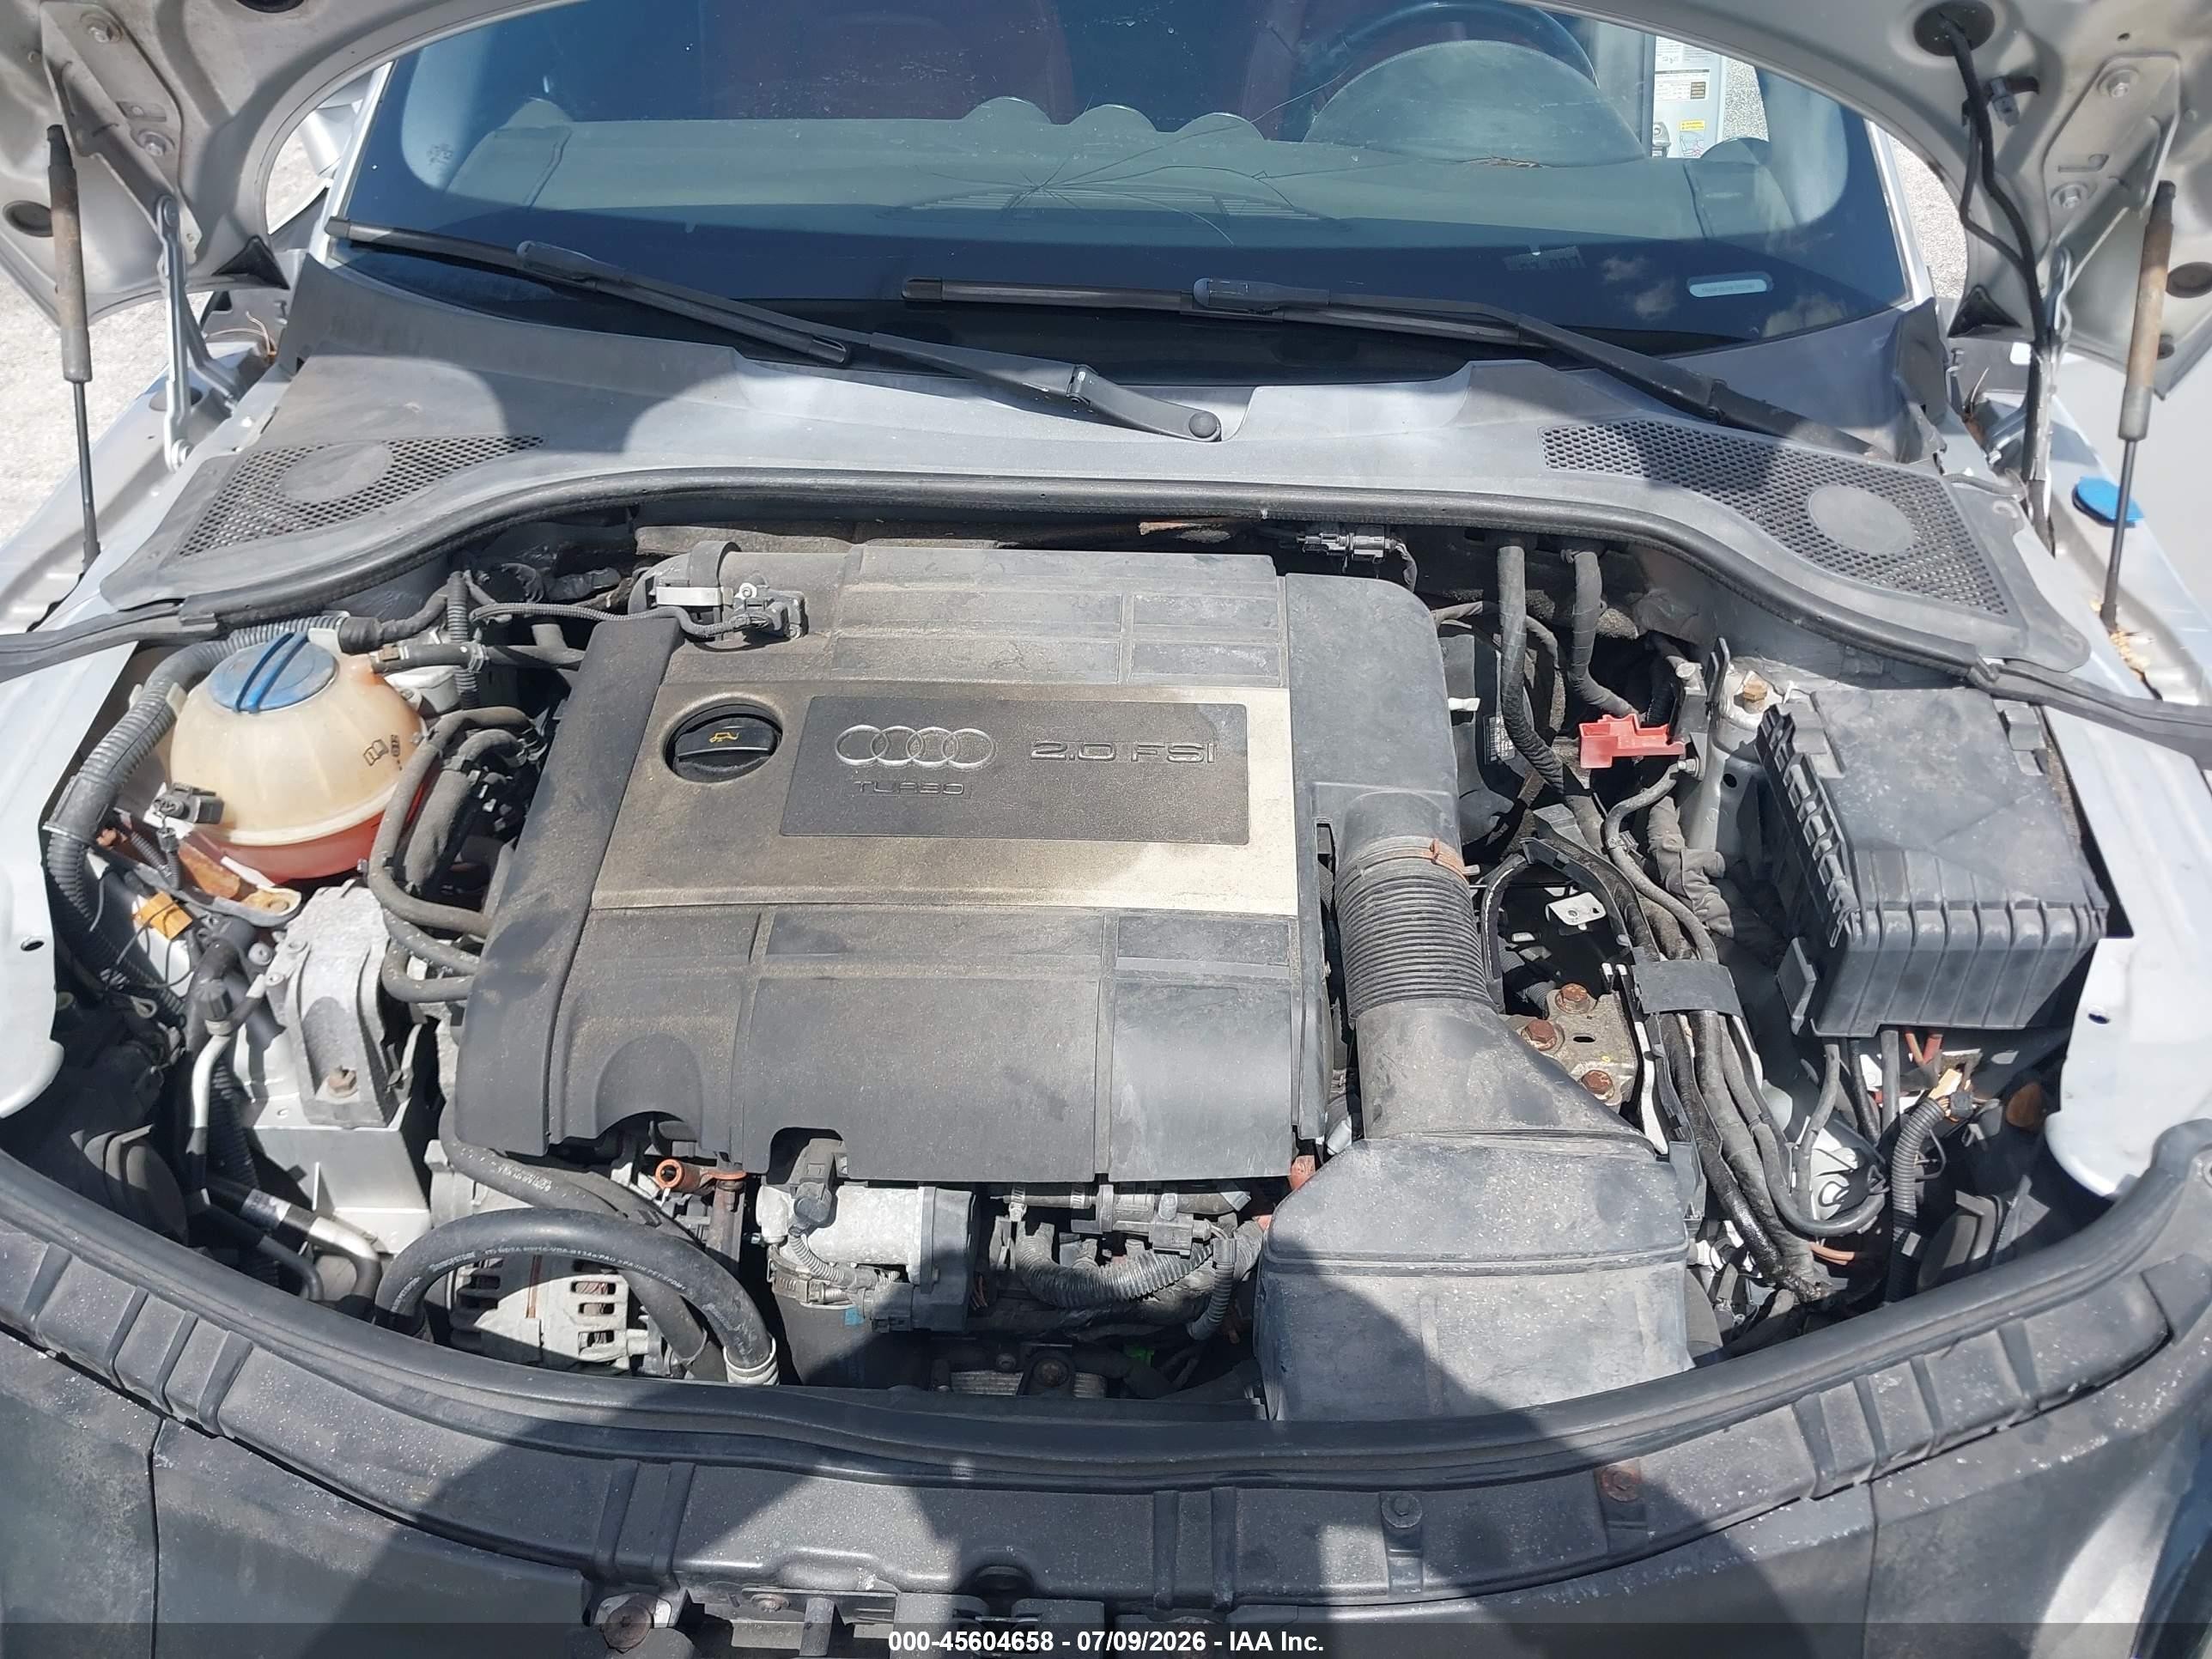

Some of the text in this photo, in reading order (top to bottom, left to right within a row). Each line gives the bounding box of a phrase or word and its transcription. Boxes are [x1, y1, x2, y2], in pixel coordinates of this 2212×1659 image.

[1030, 741, 1216, 763] 2.0 FSI
[854, 780, 964, 795] TURBO
